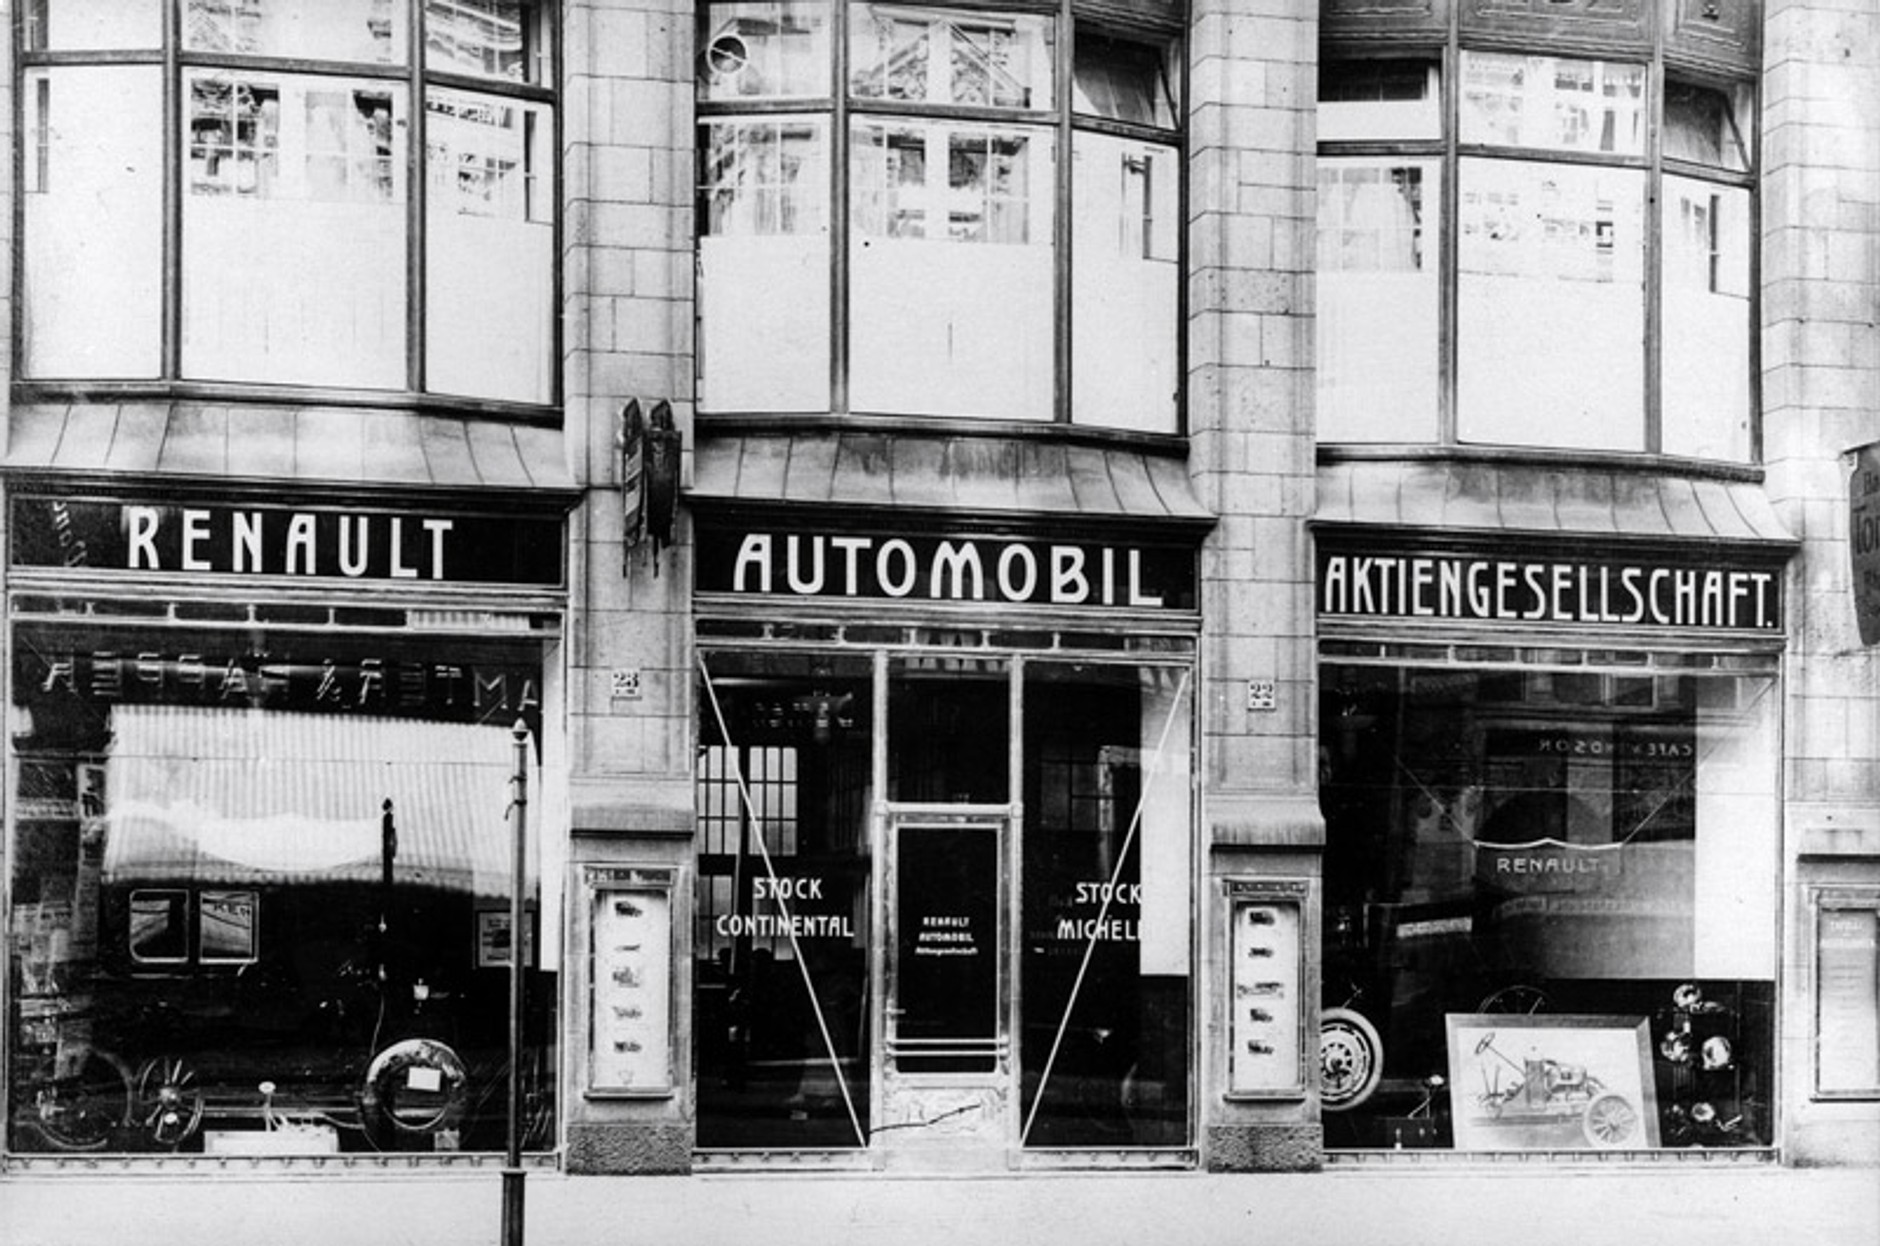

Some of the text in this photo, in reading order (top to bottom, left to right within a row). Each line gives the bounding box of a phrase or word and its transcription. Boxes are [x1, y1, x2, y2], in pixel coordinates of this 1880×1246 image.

[127, 506, 453, 580] RENAULT
[732, 533, 1164, 608] AUTOMOBIL
[1324, 556, 1774, 628] AKTIENGESELLSCHAFT.
[753, 877, 823, 900] STOCK
[1075, 882, 1143, 904] STOCK
[716, 914, 855, 938] CONTINENTAL
[1057, 919, 1145, 941] MICHELI
